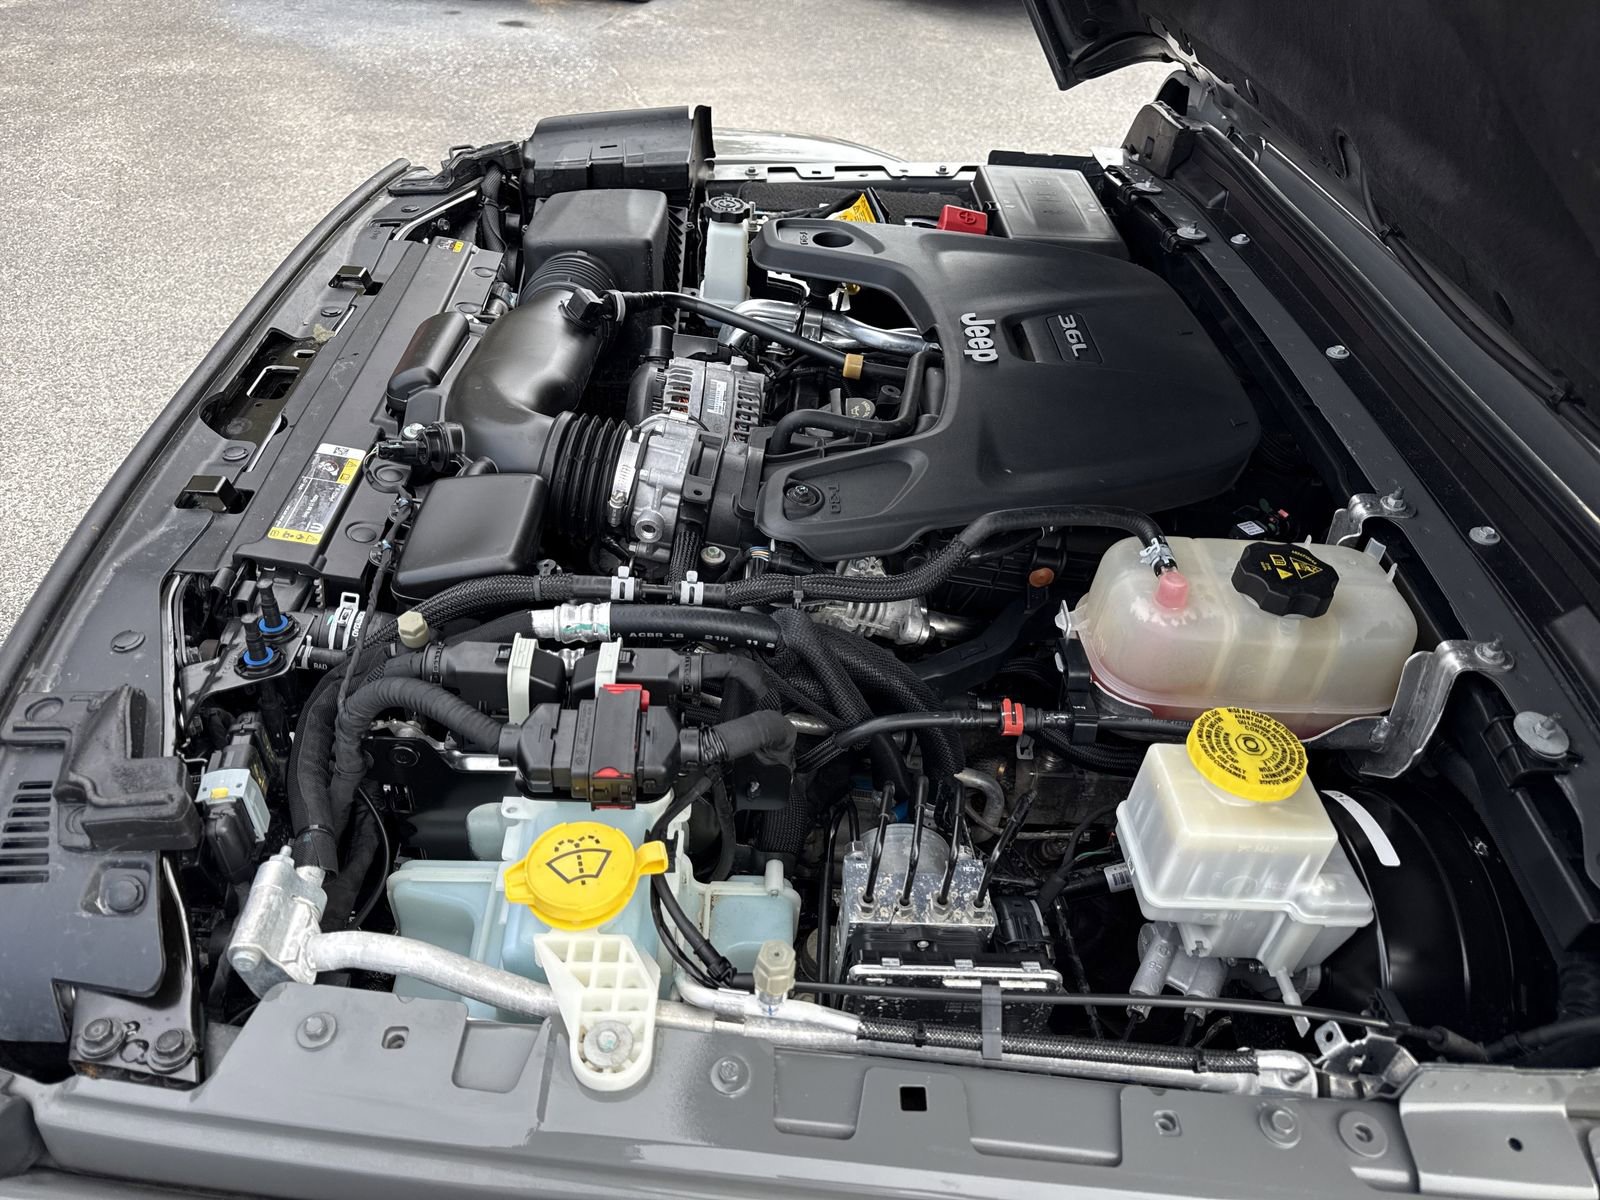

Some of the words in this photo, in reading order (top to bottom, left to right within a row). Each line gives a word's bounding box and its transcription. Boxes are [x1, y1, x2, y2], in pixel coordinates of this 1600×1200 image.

[961, 312, 999, 362] Jeep
[1217, 754, 1229, 765] USE
[1229, 763, 1246, 774] ONLY
[1226, 754, 1239, 764] CAP
